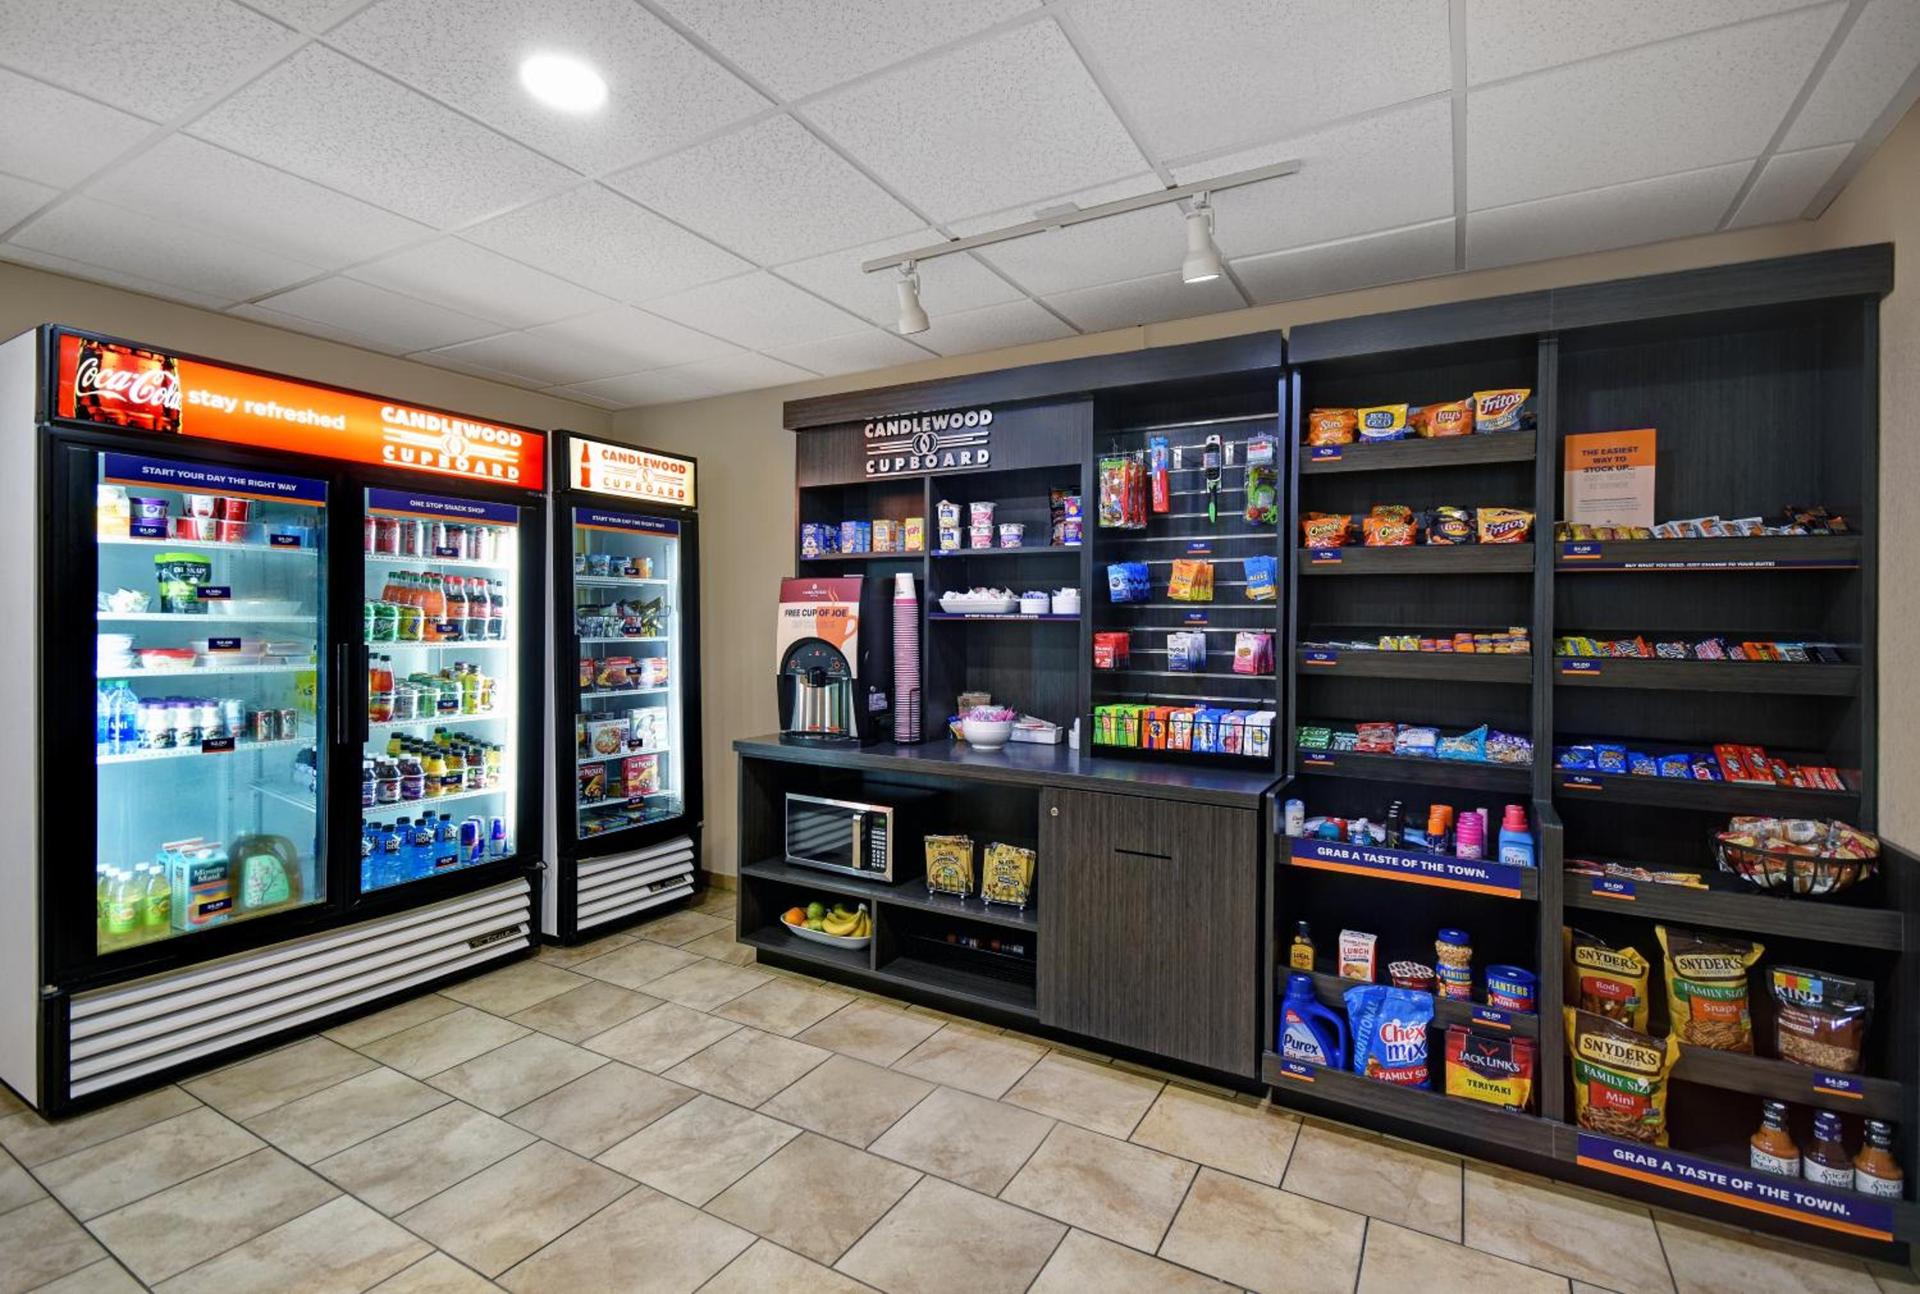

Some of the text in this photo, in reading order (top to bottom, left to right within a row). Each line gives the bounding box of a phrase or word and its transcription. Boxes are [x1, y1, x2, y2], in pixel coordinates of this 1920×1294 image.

[76, 357, 182, 411] Coca-Cola
[188, 389, 346, 430] stay refreshed
[1482, 392, 1521, 411] Fritos
[380, 406, 522, 448] CANDLEWOOD
[864, 409, 993, 439] CANDLEWOOD
[865, 449, 990, 474] CUPBOARD
[1582, 446, 1639, 456] THE EASIEST
[383, 446, 520, 481] CUPBOARD
[601, 449, 686, 475] CANDLEWOOD
[1584, 465, 1615, 473] STOCK
[142, 466, 297, 492] START YOUR DAY THE RIGHT WAY
[603, 477, 685, 498] CUPBOARD
[409, 499, 485, 514] ONE STOP SNACK SHOP
[1486, 519, 1525, 535] Fritos
[784, 608, 847, 617] FREE CUP OF JOE
[1317, 846, 1489, 879] GRAB A TASTE OF THE TOWN.
[1343, 947, 1369, 955] LUNCH
[1577, 948, 1639, 971] SNYDER'S
[1679, 954, 1743, 971] SNYDER'S
[1487, 978, 1528, 997] PLANTERS
[1596, 980, 1621, 994] Rods
[1683, 982, 1722, 1000] FAMILY
[1354, 1000, 1379, 1070] TRADITIONAL
[1380, 1022, 1426, 1043] Chex
[1284, 1033, 1318, 1056] Purex
[1583, 1037, 1657, 1066] SNYDER'S
[1458, 1050, 1485, 1066] JACK
[1379, 1070, 1413, 1081] FAMILY
[1583, 1064, 1624, 1089] FAMILY
[1466, 1078, 1512, 1096] TERIYAKI
[1605, 1090, 1635, 1106] Mini
[1613, 1148, 1850, 1216] GRAB A TASTE OF THE TOWN.
